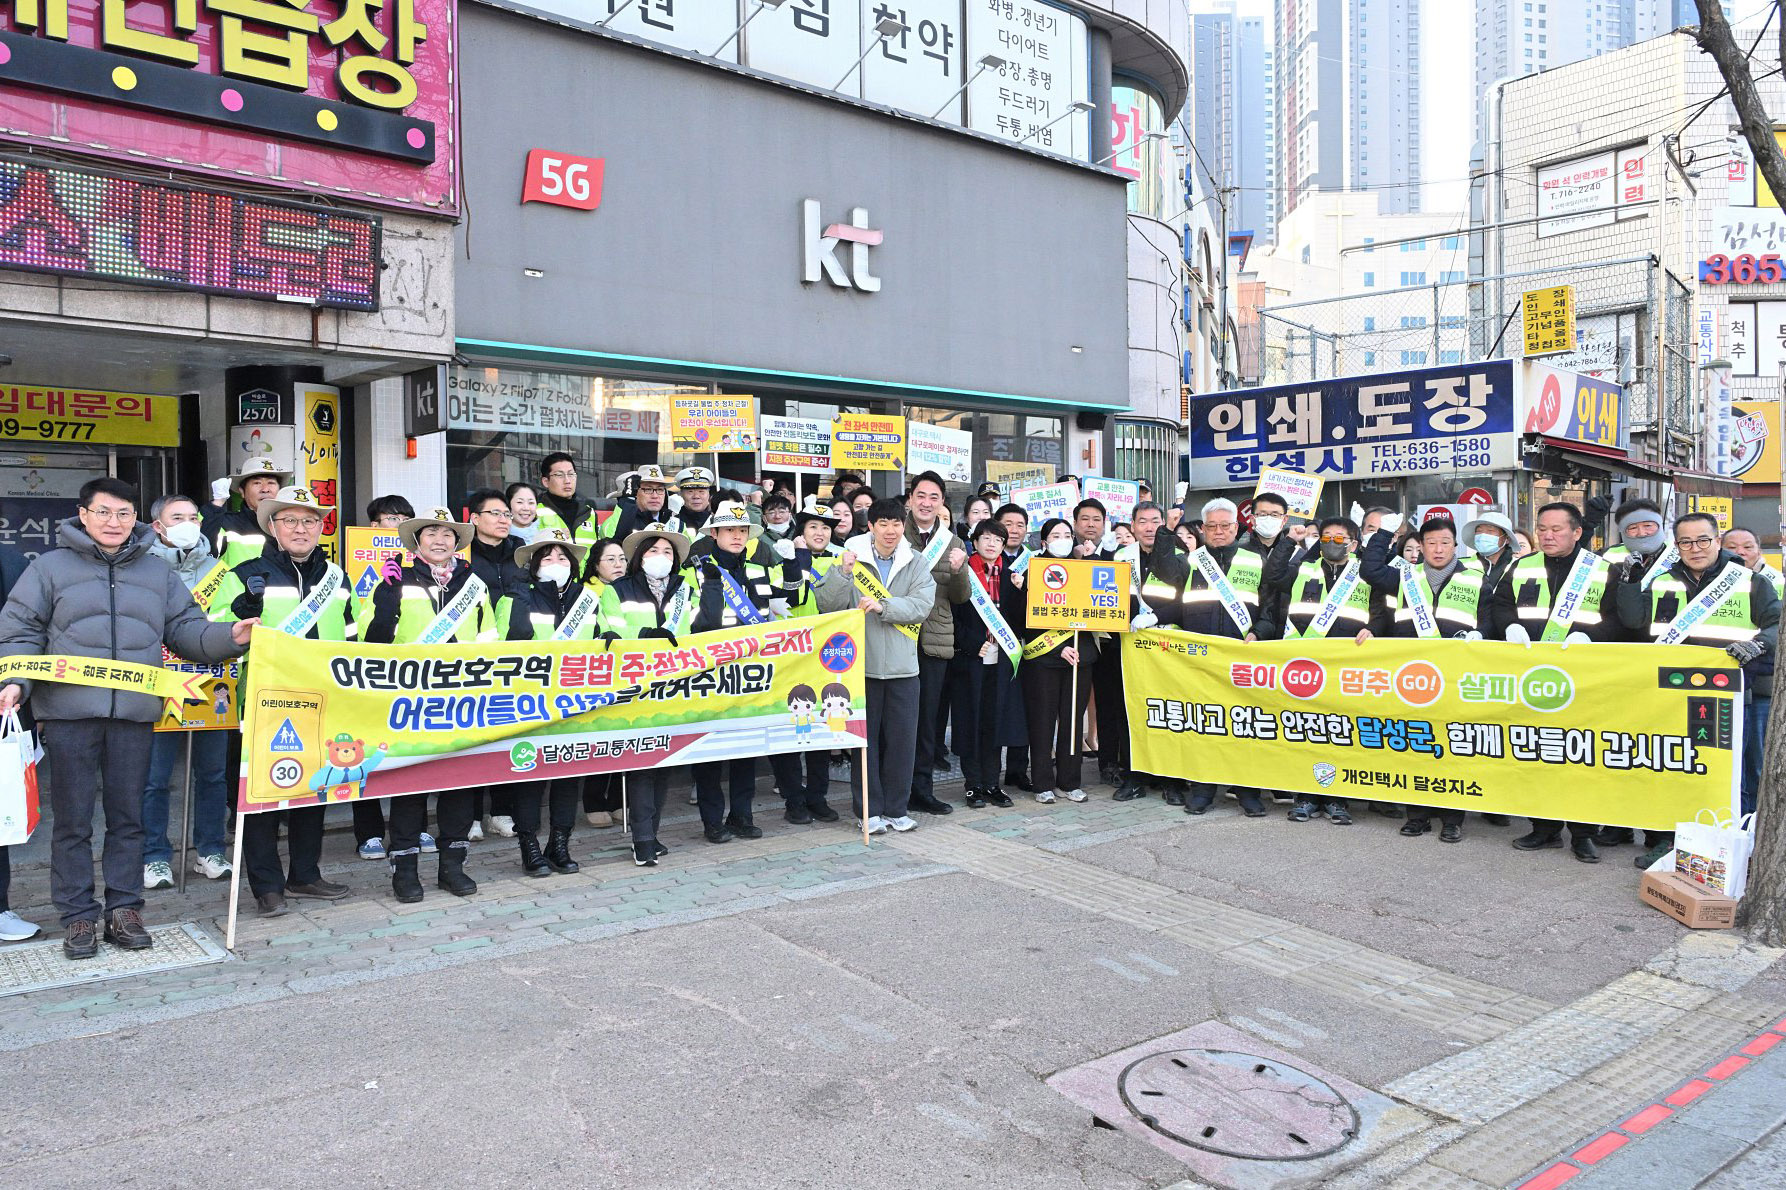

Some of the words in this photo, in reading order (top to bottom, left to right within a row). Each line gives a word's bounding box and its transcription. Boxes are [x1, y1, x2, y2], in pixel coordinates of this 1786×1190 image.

[998, 29, 1049, 60] 다이어트
[999, 87, 1050, 118] 두드러기
[996, 114, 1052, 147] 두통.비염
[541, 159, 591, 201] 5G
[1559, 183, 1601, 199] 716-2240
[801, 198, 883, 293] kt
[1706, 254, 1783, 285] 365
[1528, 339, 1566, 351] 청첩장
[1731, 320, 1746, 359] 척추
[448, 376, 498, 397] Galaxy
[500, 383, 508, 396] Z
[547, 389, 554, 401] Z
[416, 381, 434, 418] kt
[701, 400, 712, 408] 불법
[243, 407, 276, 421] 2570
[449, 394, 493, 424] 여는
[499, 401, 536, 427] 순간
[540, 406, 593, 431] 펼쳐지는
[688, 409, 704, 418] 우리
[706, 409, 737, 418] 아이들의
[1577, 387, 1618, 447] 인쇄
[680, 418, 704, 427] 안전이
[706, 418, 747, 427] 우선입니다!
[787, 421, 805, 431] 지키는
[844, 420, 852, 431] 전
[853, 421, 869, 431] 좌석
[870, 422, 893, 432] 안전띠
[764, 429, 782, 438] 안전한
[839, 433, 855, 441] 생명을
[872, 434, 898, 443] 기본입니다
[785, 441, 806, 452] 착용은
[911, 439, 945, 452] 대구로페이로
[946, 446, 969, 457] 결제하면
[1371, 437, 1491, 458] TEL:636-1580
[784, 456, 811, 466] 주차구역
[1371, 453, 1491, 473] FAX:636-1580
[1097, 482, 1110, 491] 교통
[1111, 483, 1125, 492] 안전
[1294, 478, 1314, 489] 정지선
[1028, 491, 1044, 500] 교통
[1045, 488, 1062, 498] 질서
[1106, 490, 1134, 504] 자라나요
[1287, 486, 1299, 495] 밝은
[1300, 488, 1313, 498] 미소
[1026, 501, 1043, 512] 함께
[1043, 498, 1068, 509] 지켜요
[354, 549, 377, 562] 우리
[1235, 569, 1259, 579] 개인택시
[1450, 585, 1477, 598] 개인택시
[1700, 567, 1743, 608] 교통안전을
[1044, 592, 1066, 605] NO!
[1090, 594, 1119, 608] YES!
[1446, 592, 1475, 605] 달성군지소
[1557, 591, 1579, 619] 합시다
[1032, 606, 1048, 616] 불법
[1050, 607, 1078, 617] 주·정차
[1082, 608, 1107, 619] 올바른
[1109, 609, 1126, 620] 주차
[1230, 601, 1249, 626] 합시다
[1316, 603, 1337, 627] 합시다
[1414, 604, 1432, 631] 합시다
[1675, 604, 1706, 632] 생활화
[822, 647, 853, 657] 주정차금지
[1187, 643, 1208, 657] 달성
[330, 653, 553, 690] 어린이보호구역
[559, 652, 615, 688] 불법
[620, 648, 707, 685] 주·정차
[706, 635, 759, 667] 절대
[758, 627, 814, 657] 금지!
[82, 665, 108, 680] 함께
[109, 668, 144, 684] 지켜요
[1231, 662, 1277, 689] 줄이
[1287, 667, 1320, 686] GO!
[1340, 669, 1391, 696] 멈추
[1401, 673, 1437, 692] GO!
[1458, 673, 1516, 704] 살피
[1528, 678, 1566, 699] GO!
[261, 699, 318, 710] 어린이보호구역
[388, 692, 553, 731] 어린이들의
[1146, 698, 1227, 737] 교통사고
[1229, 705, 1279, 742] 없는
[1281, 709, 1353, 747] 안전한
[1355, 716, 1444, 758] 달성군,
[1447, 722, 1504, 759] 함께
[1508, 724, 1596, 767] 만들어
[1602, 731, 1708, 775] 갑시다.
[543, 741, 591, 763] 달성군
[593, 734, 671, 758] 교통지도과
[276, 766, 298, 781] 30
[1341, 768, 1408, 790] 개인택시
[1413, 775, 1484, 797] 달성지소
